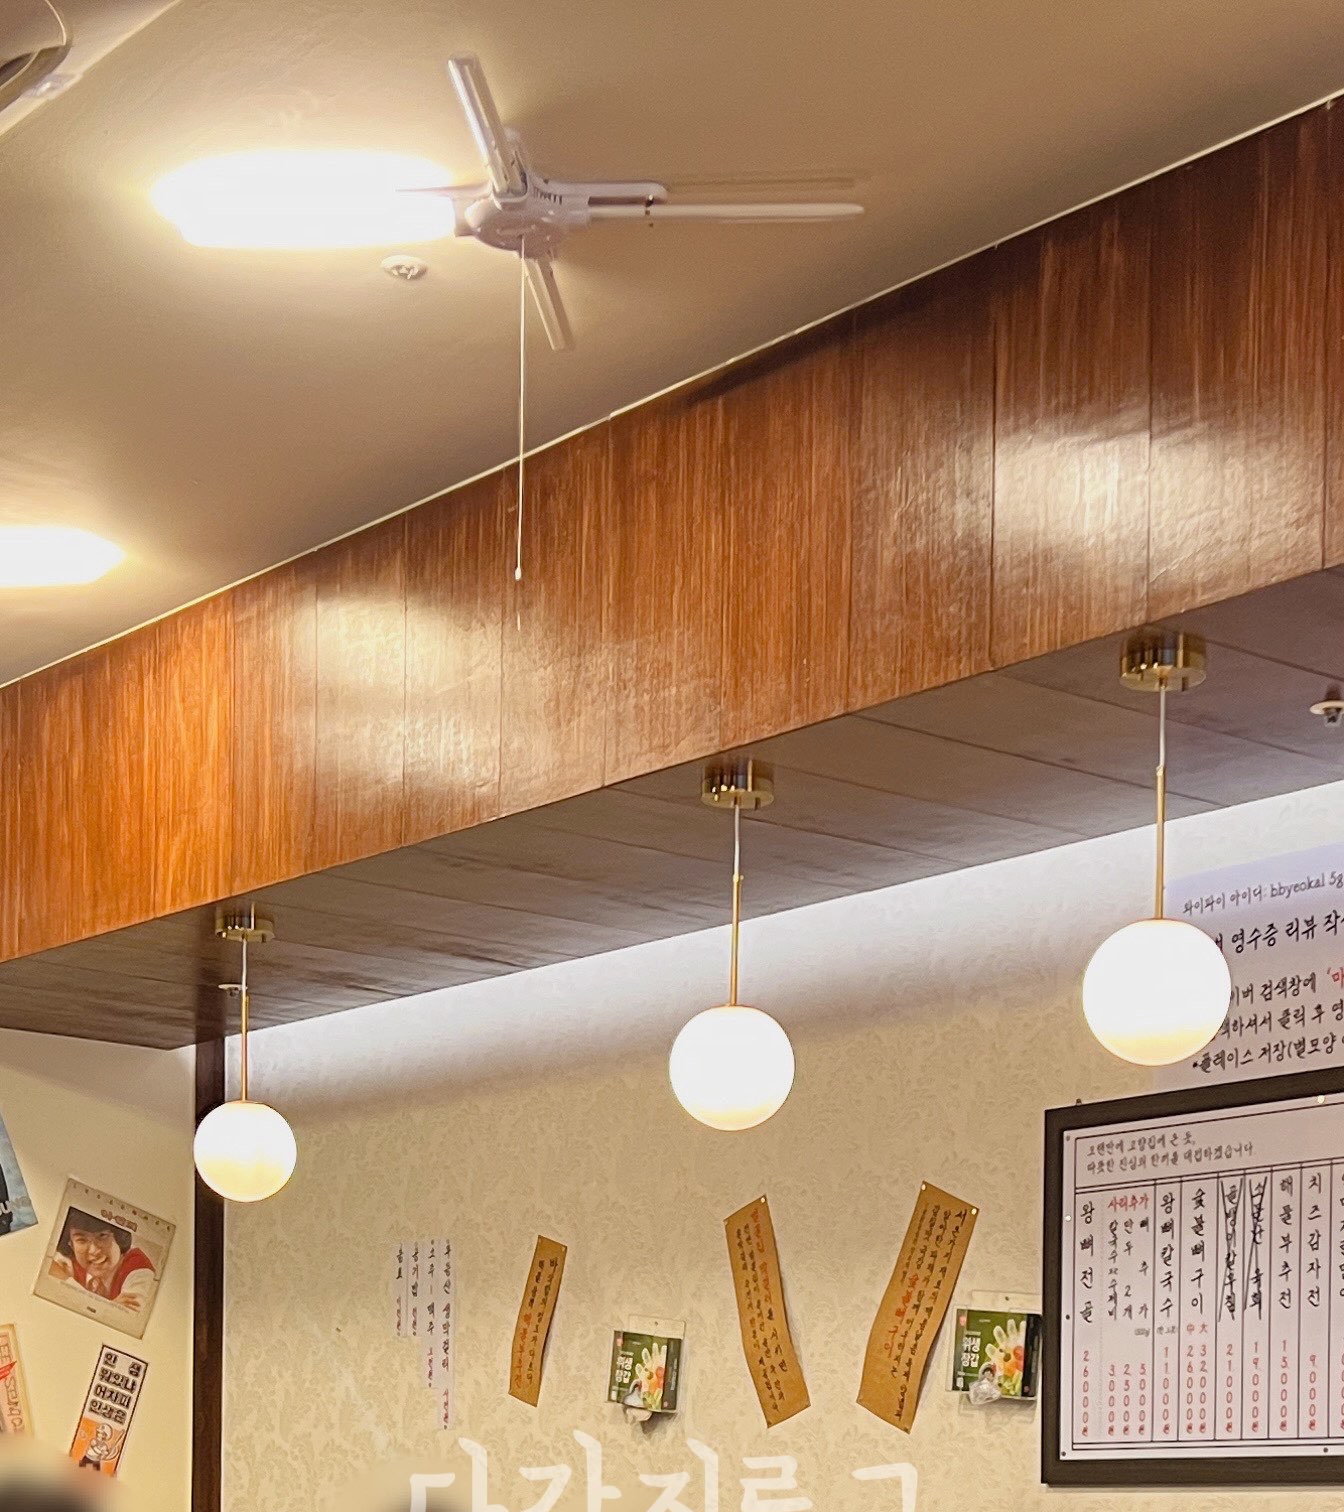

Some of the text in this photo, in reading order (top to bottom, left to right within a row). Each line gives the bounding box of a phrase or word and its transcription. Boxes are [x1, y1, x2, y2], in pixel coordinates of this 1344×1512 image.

[1231, 925, 1278, 955] 영수증
[1285, 913, 1319, 943] 리뷰
[1259, 974, 1317, 1002] 검색창에
[1079, 1200, 1096, 1324] 왕뼈전골
[1306, 1172, 1323, 1308] 치즈감자전
